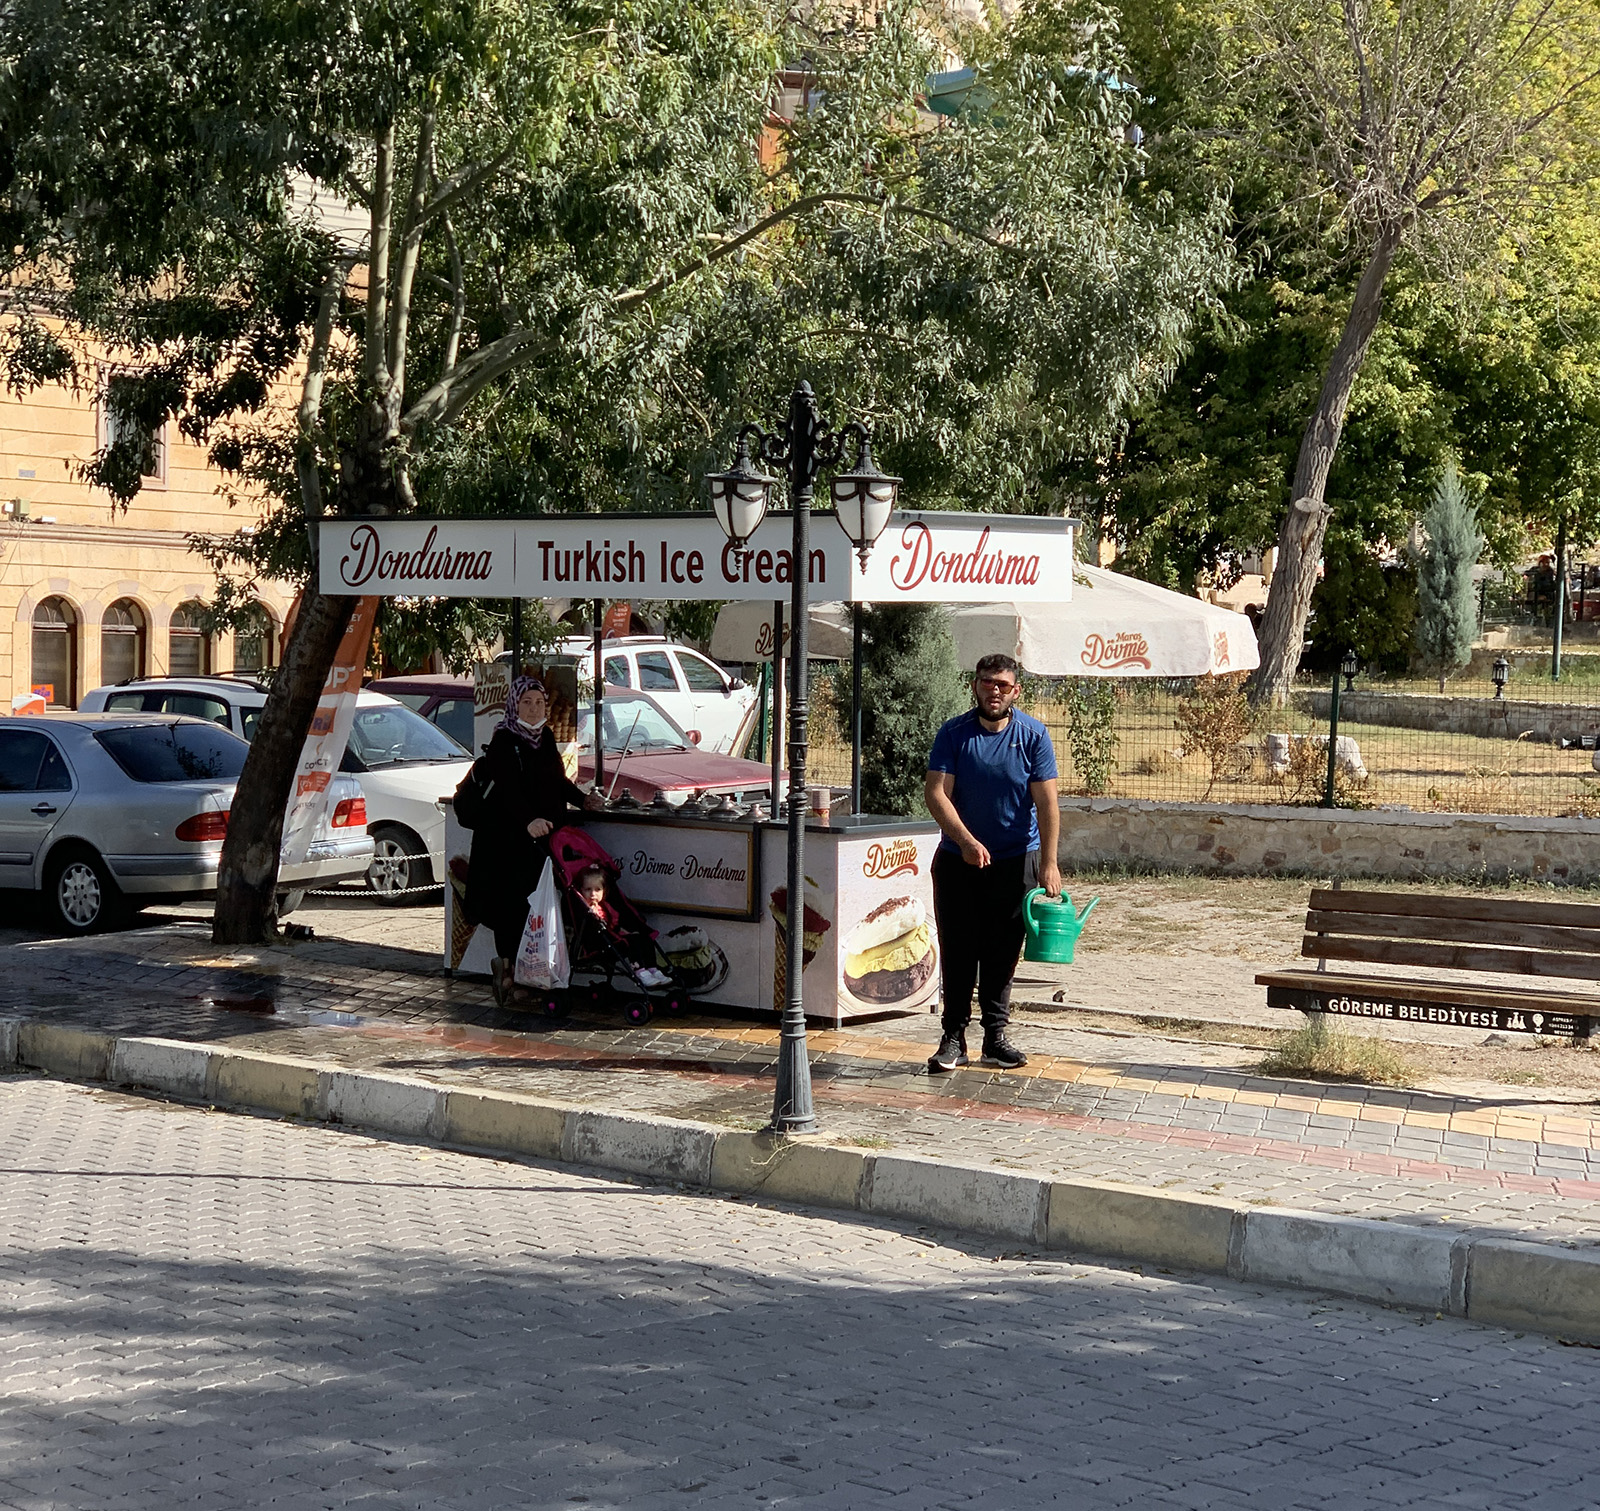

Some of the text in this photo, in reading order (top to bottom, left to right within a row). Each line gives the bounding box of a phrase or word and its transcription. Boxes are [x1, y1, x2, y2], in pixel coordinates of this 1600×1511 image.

[340, 524, 493, 587] Dondurma
[538, 540, 645, 583] Turkish
[660, 541, 704, 584] Ice
[890, 520, 1040, 591] Dondurma
[1081, 633, 1149, 666] Dövme
[474, 682, 510, 706] övme
[680, 855, 747, 882] Dondurma
[863, 844, 918, 878] Dövme
[1328, 997, 1499, 1027] GÖREME BELEDİYESİ
